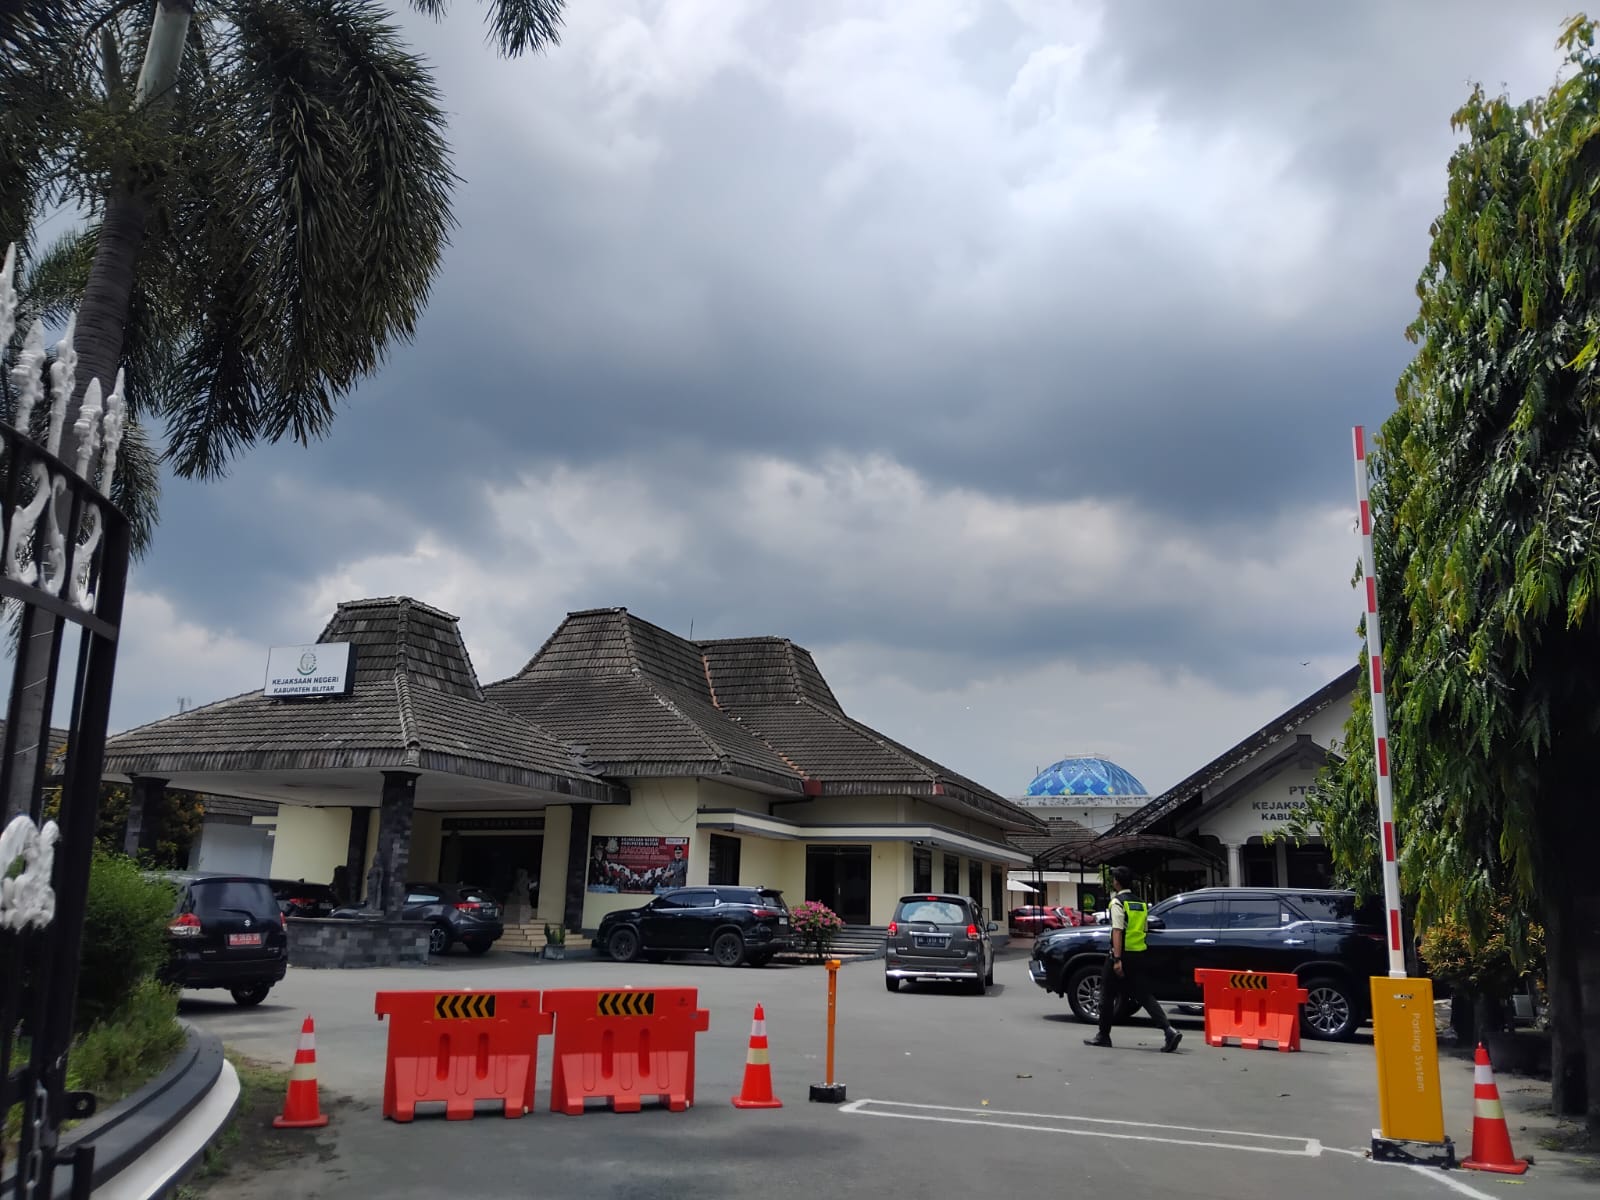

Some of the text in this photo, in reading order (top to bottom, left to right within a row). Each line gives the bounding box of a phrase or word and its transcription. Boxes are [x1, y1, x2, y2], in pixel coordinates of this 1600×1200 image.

[272, 676, 339, 685] KEJAKSAAN NEGERI
[273, 685, 335, 694] KABUPATEN BLITAR
[1252, 801, 1307, 810] KEJAKSA
[1412, 1012, 1422, 1052] Parking
